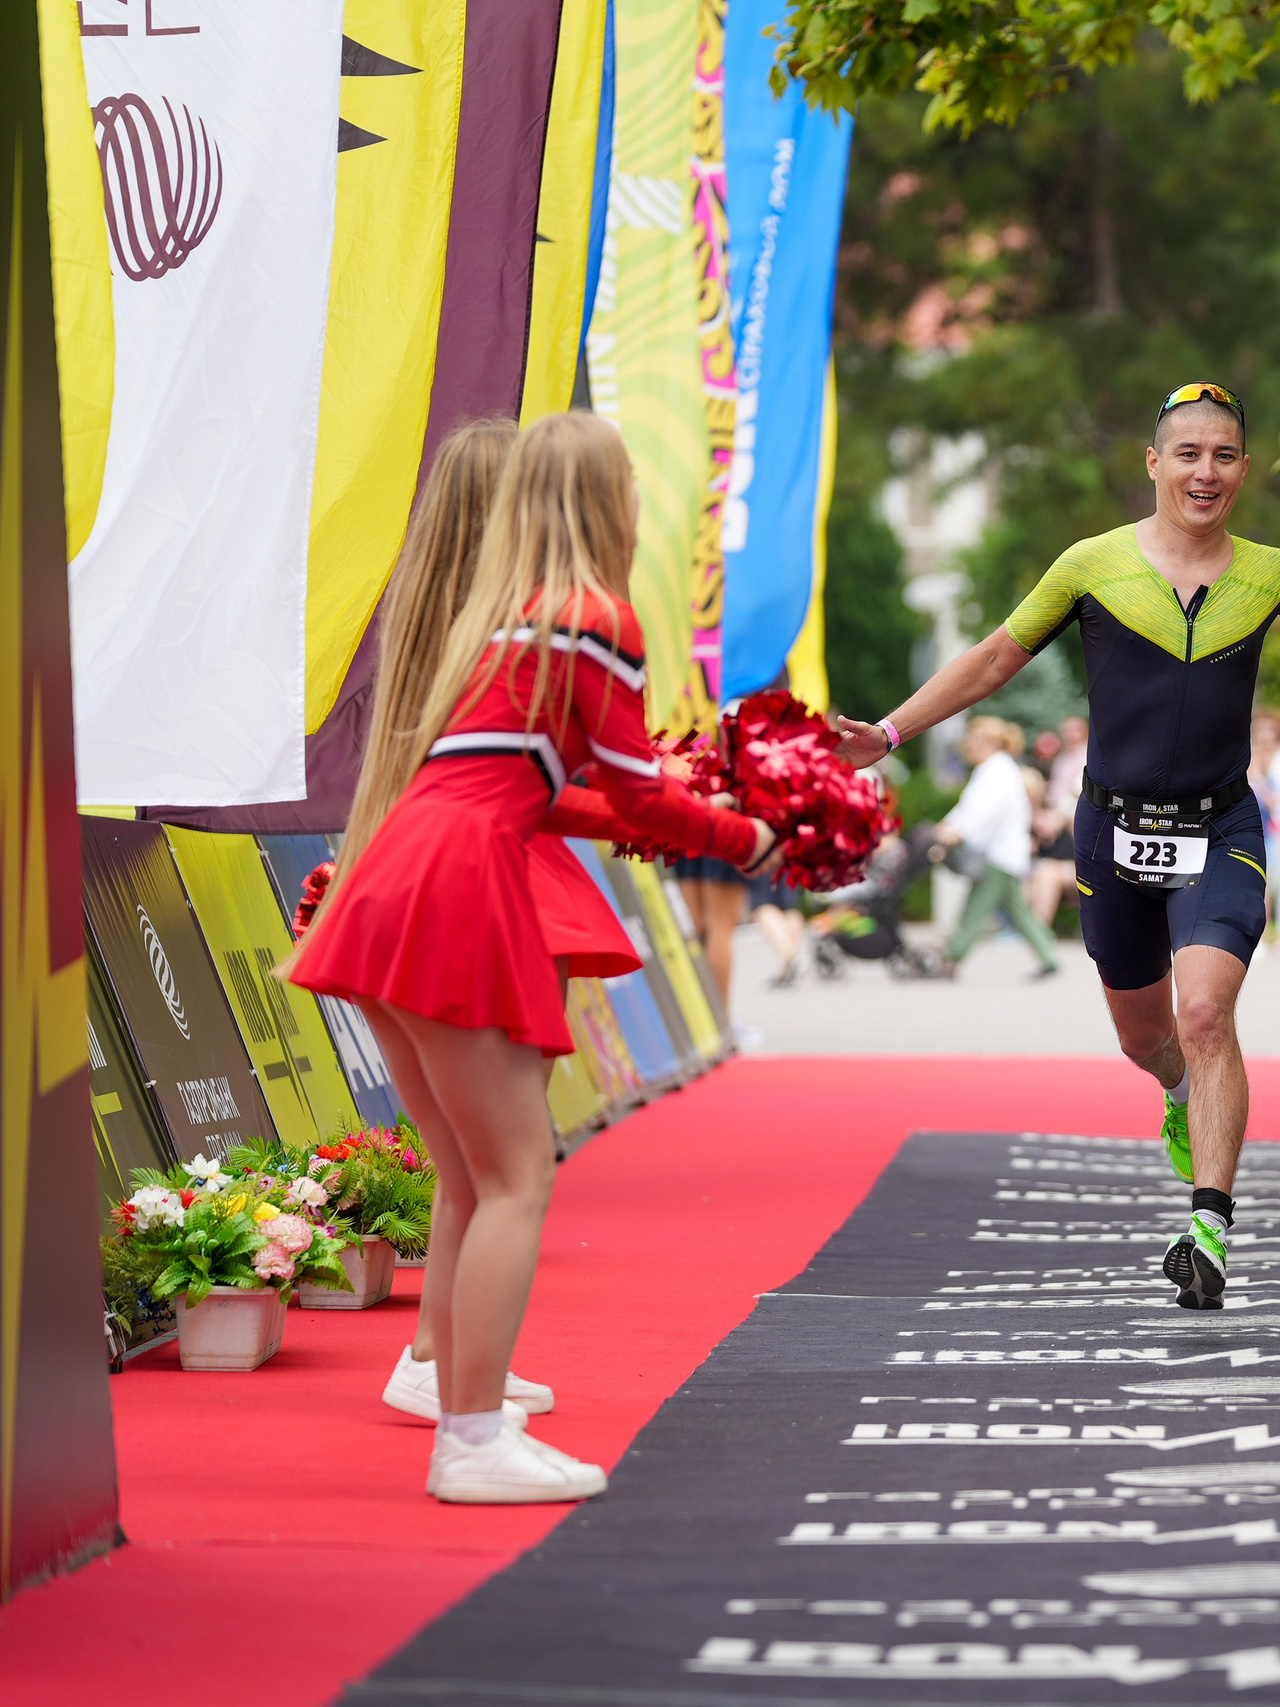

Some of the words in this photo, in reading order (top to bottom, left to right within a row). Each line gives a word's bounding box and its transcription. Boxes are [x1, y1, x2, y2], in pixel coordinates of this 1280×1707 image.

[1142, 803, 1157, 812] IRON
[1162, 803, 1178, 812] STAR
[1139, 817, 1153, 825] IRON
[1158, 819, 1173, 827] STAR
[1130, 840, 1177, 867] 223
[1138, 873, 1165, 883] SAMAT
[222, 950, 276, 1043] IRON
[176, 1075, 242, 1125] ГАЗПРОМБАНК
[922, 1298, 1168, 1309] IRON
[892, 1348, 1169, 1362] IRON
[850, 1423, 1167, 1440] IRON
[790, 1520, 1157, 1540] IRON
[699, 1636, 1140, 1669] IRON
